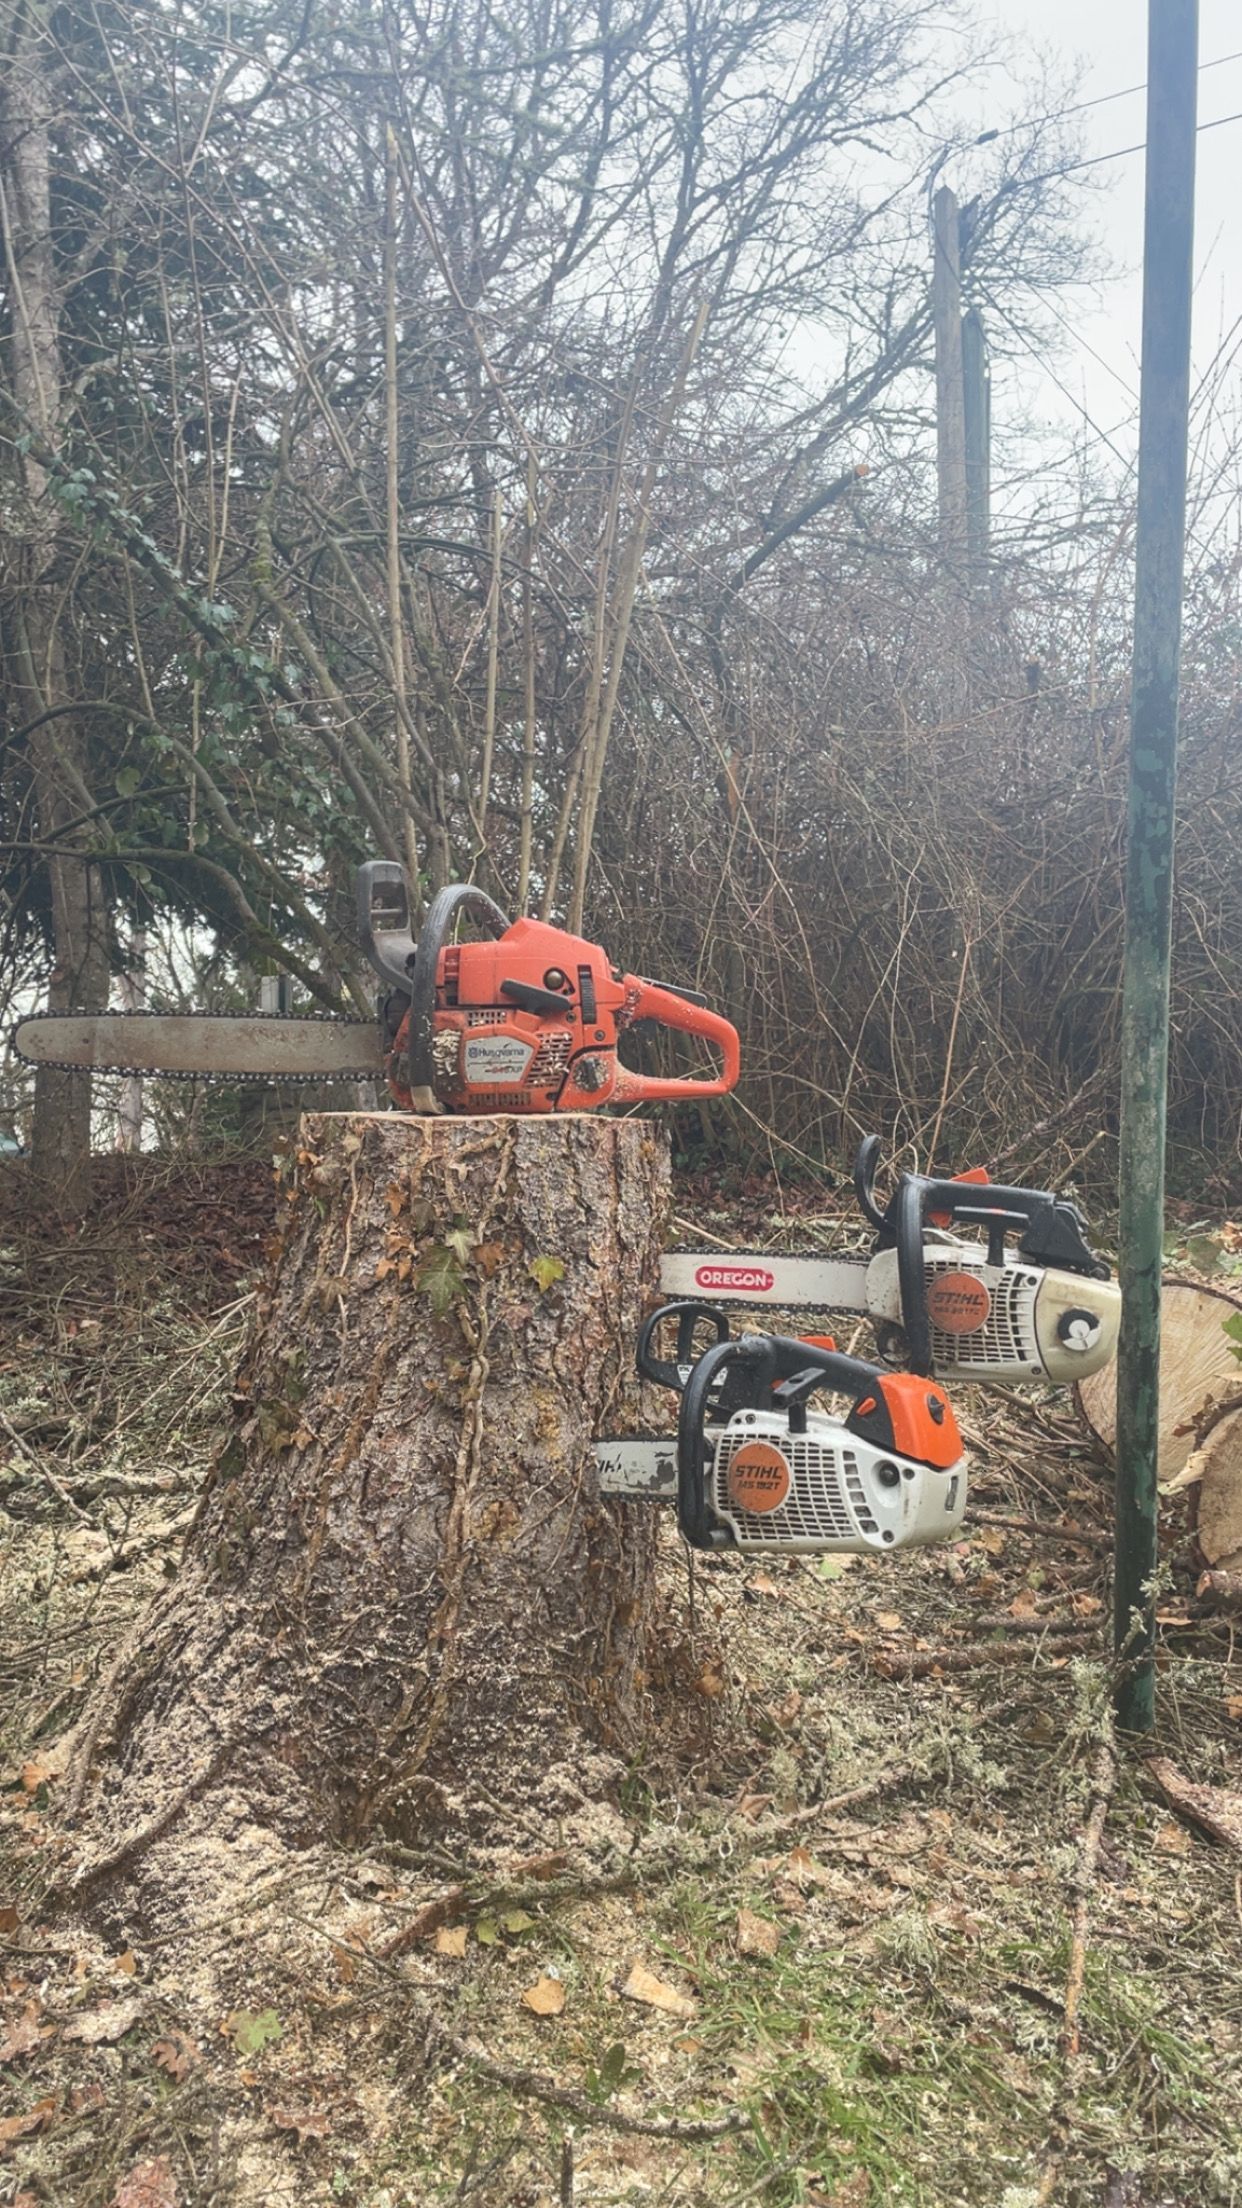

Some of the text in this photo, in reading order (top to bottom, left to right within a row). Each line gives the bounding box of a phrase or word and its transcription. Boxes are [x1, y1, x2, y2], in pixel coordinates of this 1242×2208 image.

[700, 1270, 767, 1287] OREGON
[932, 1291, 984, 1305] STIHL
[735, 1464, 783, 1480] STIHL
[738, 1480, 781, 1491] MS 192T
